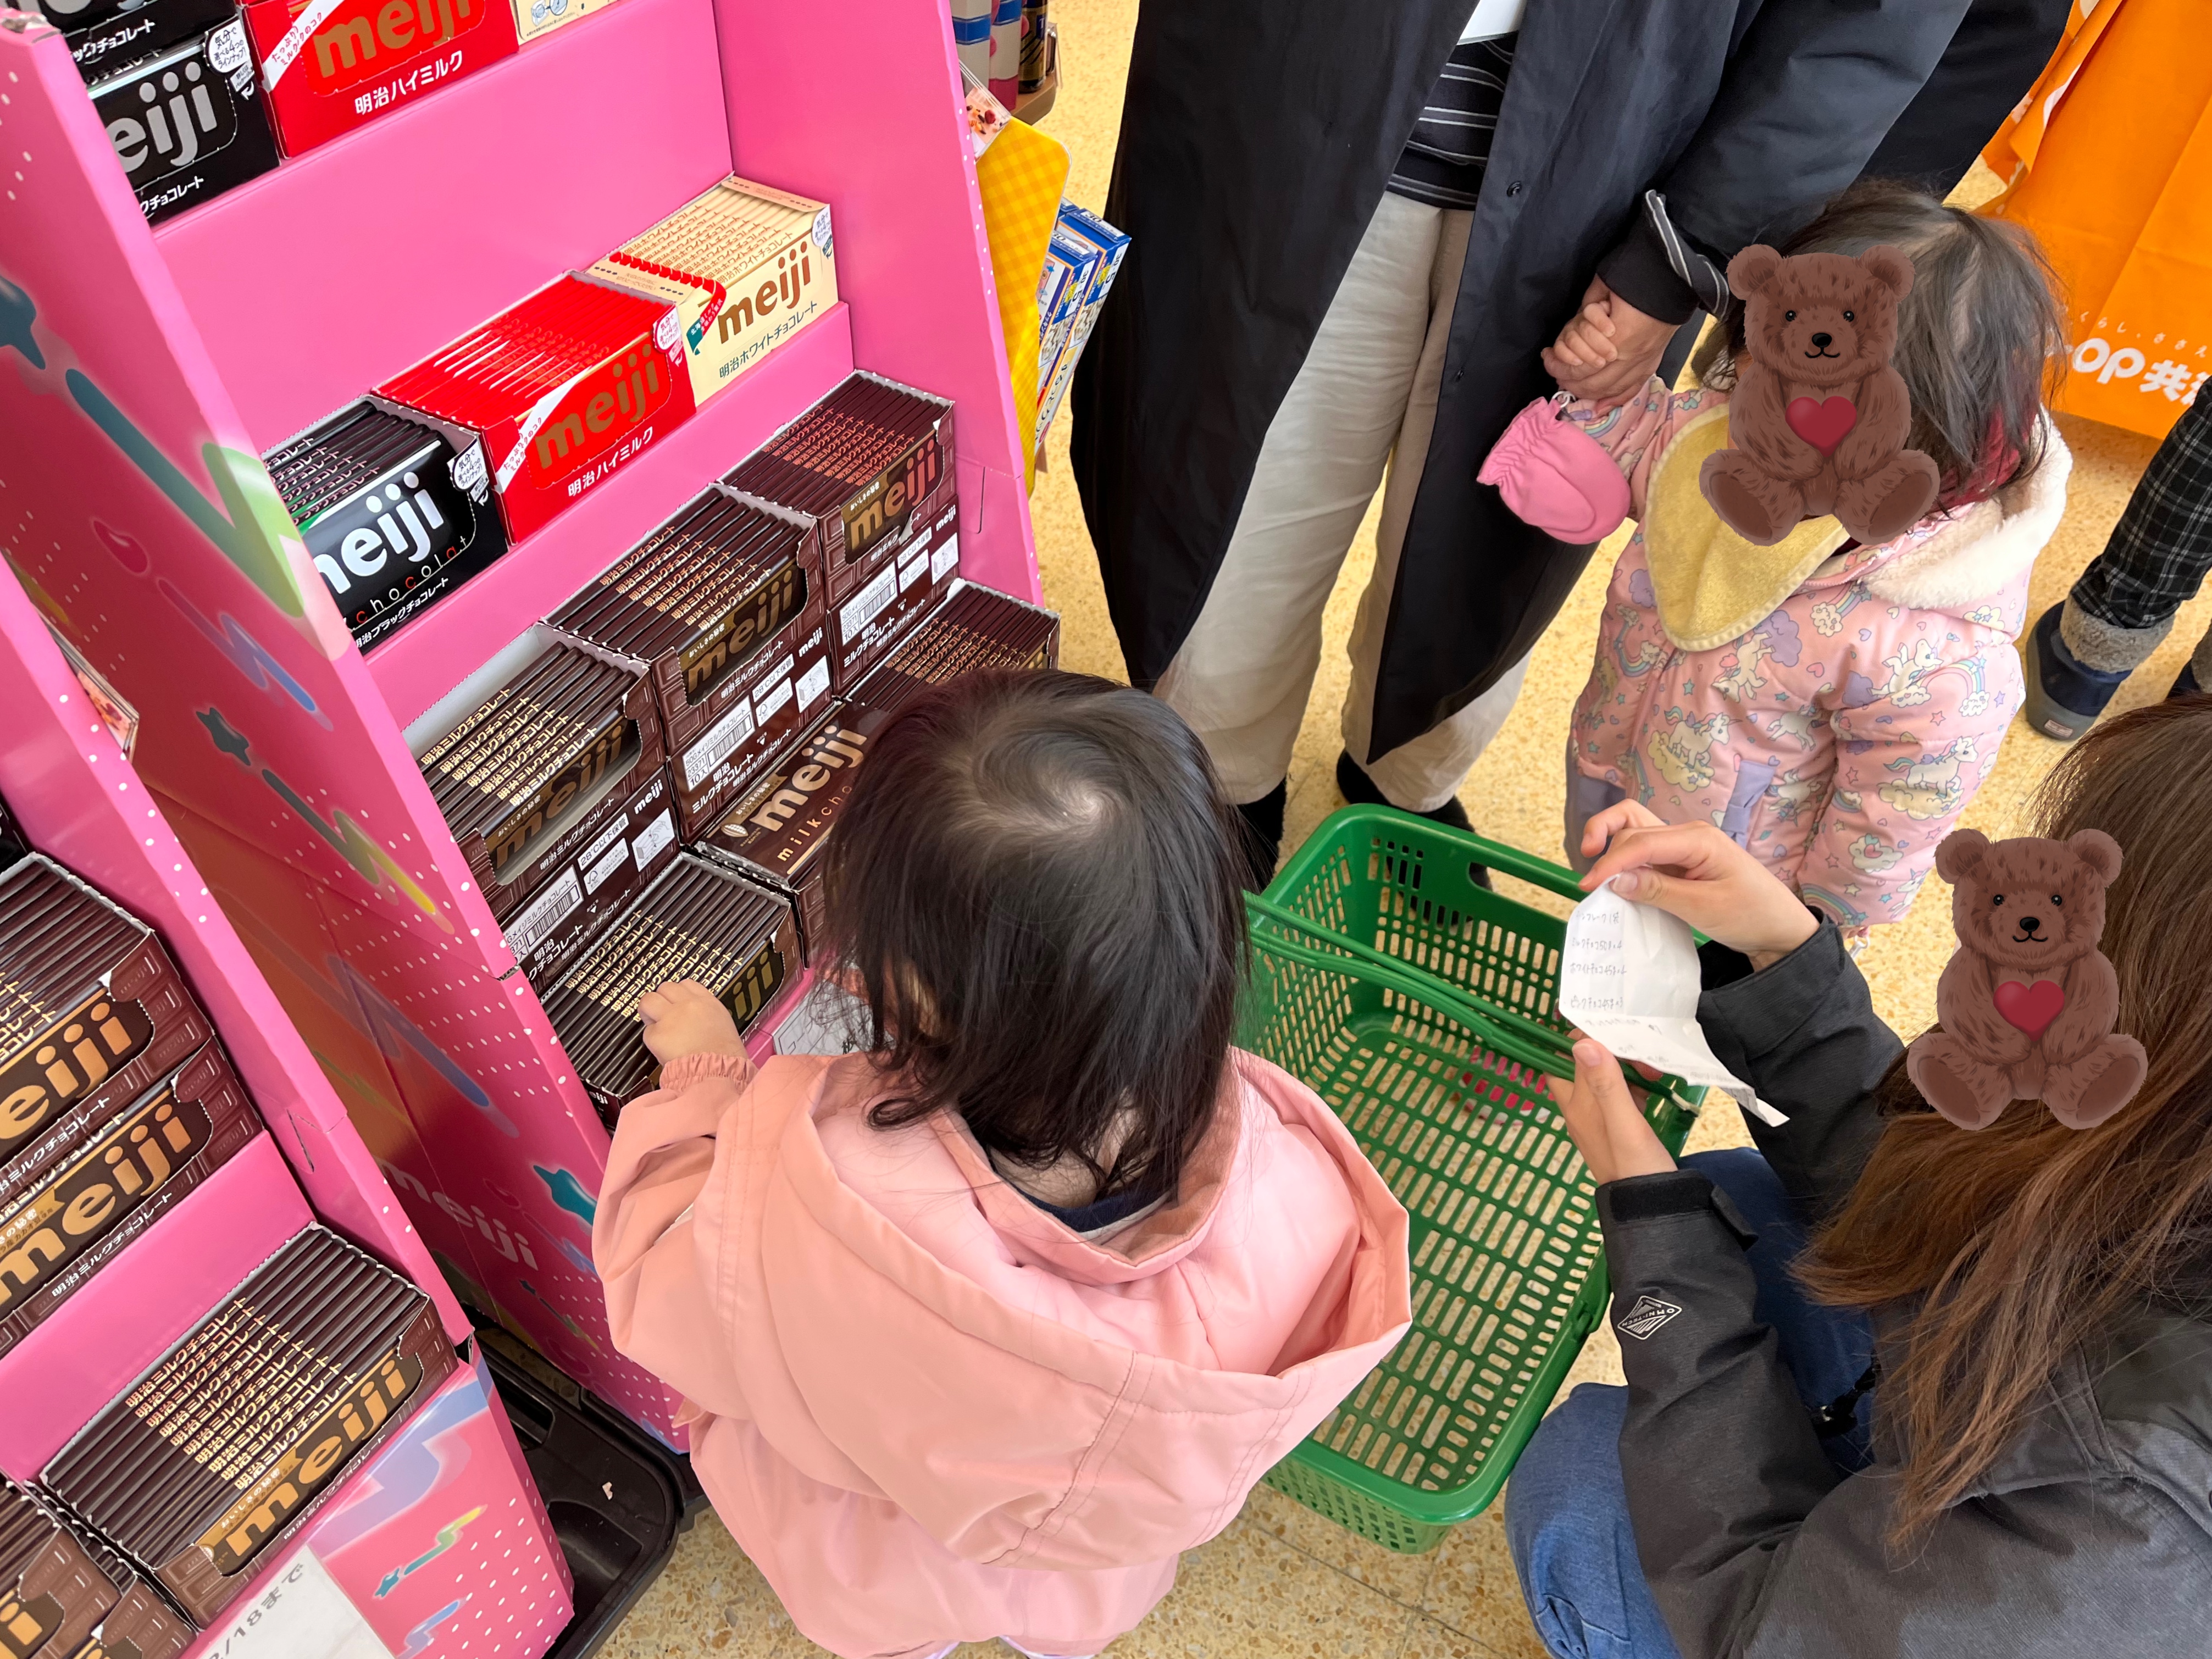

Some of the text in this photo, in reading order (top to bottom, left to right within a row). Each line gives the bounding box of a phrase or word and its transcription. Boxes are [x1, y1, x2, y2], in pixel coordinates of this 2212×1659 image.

[354, 50, 463, 115] 明治ハイミルク
[717, 231, 793, 284] 明治ホワイトチョコレート
[717, 241, 812, 344] meiji
[719, 300, 818, 379] 明治ホワイトチョコレート
[535, 344, 659, 470] meiji
[762, 404, 823, 453] 明治ミルクチョコレート
[772, 408, 834, 457] 明治ミルクチョコレート
[783, 412, 844, 461] 明治ミルクチョコレート
[792, 416, 855, 465] 明治ミルクチョコレート
[803, 419, 864, 469] 明治ミルクチョコレート
[567, 425, 655, 497] 明治ハイミルク
[813, 423, 874, 473] 明治ミルクチョコレート
[824, 427, 885, 477] 明治ミルクチョコレート
[834, 430, 895, 480] 明治ミルクチョコレート
[845, 433, 905, 484] 明治ミルクチョコレート
[855, 436, 915, 486] 明治ミルクチョコレート
[850, 439, 936, 550] meiji
[936, 504, 956, 531] meiji
[599, 526, 675, 586] 明治ミルクチョコレート
[616, 533, 690, 594] 明治ミルクチョコレート
[629, 540, 703, 601] 明治ミルクチョコレート
[643, 546, 717, 607] 明治ミルクチョコレート
[656, 551, 730, 612] 明治ミルクチョコレート
[671, 558, 744, 619] 明治ミルクチョコレート
[685, 563, 758, 626] 明治ミルクチョコレート
[688, 570, 792, 694] meiji
[698, 568, 771, 631] 明治ミルクチョコレート
[861, 622, 877, 640] 明治
[799, 626, 823, 657] meiji
[844, 616, 895, 668] ミルクチョコレート
[420, 689, 511, 765] 明治ミルクチョコレート
[439, 697, 530, 773] 明治ミルクチョコレート
[451, 703, 541, 781] 明治ミルクチョコレート
[467, 709, 556, 788] 明治ミルクチョコレート
[480, 715, 569, 794] 明治ミルクチョコレート
[496, 722, 585, 800] 明治ミルクチョコレート
[497, 725, 622, 869] meiji
[509, 728, 597, 807] 明治ミルクチョコレート
[634, 779, 663, 814] meiji
[687, 758, 706, 778] 23371
[692, 753, 754, 814] ミルクチョコレート
[712, 762, 730, 783] 明治
[749, 724, 868, 832] meiji
[777, 818, 822, 862] milk
[527, 924, 583, 981] クチョコレート
[533, 938, 555, 962] 明治
[564, 909, 642, 989] 明治ミルクチョコレート
[576, 914, 653, 995] 明治ミルクチョコレート
[587, 920, 664, 1001] 明治ミルクチョコレート
[600, 926, 678, 1007] 明治ミルクチョコレート
[611, 931, 688, 1012] 明治ミルクチョコレート
[728, 951, 774, 1022] iji
[0, 1002, 132, 1139] eiji
[0, 1104, 191, 1305] meiji
[380, 1157, 539, 1272] meiji
[51, 1192, 173, 1297] 明治ミルクチョコレート
[125, 1297, 246, 1408] 明治ミルクチョコレート
[135, 1306, 254, 1418] 明治ミルクチョコレート
[146, 1314, 266, 1427] 明治ミルクチョコレート
[159, 1323, 280, 1438] 明治ミルクチョコレート
[169, 1331, 290, 1446] 明治ミルクチョコレート
[183, 1340, 304, 1455] 明治ミルクチョコレート
[195, 1347, 315, 1464] 明治ミルクチョコレート
[208, 1355, 329, 1473] 明治ミルクチョコレート
[221, 1363, 342, 1480] 明治ミルクチョコレート
[234, 1372, 357, 1490] 明治ミルクチョコレート
[226, 1359, 406, 1557] meiji
